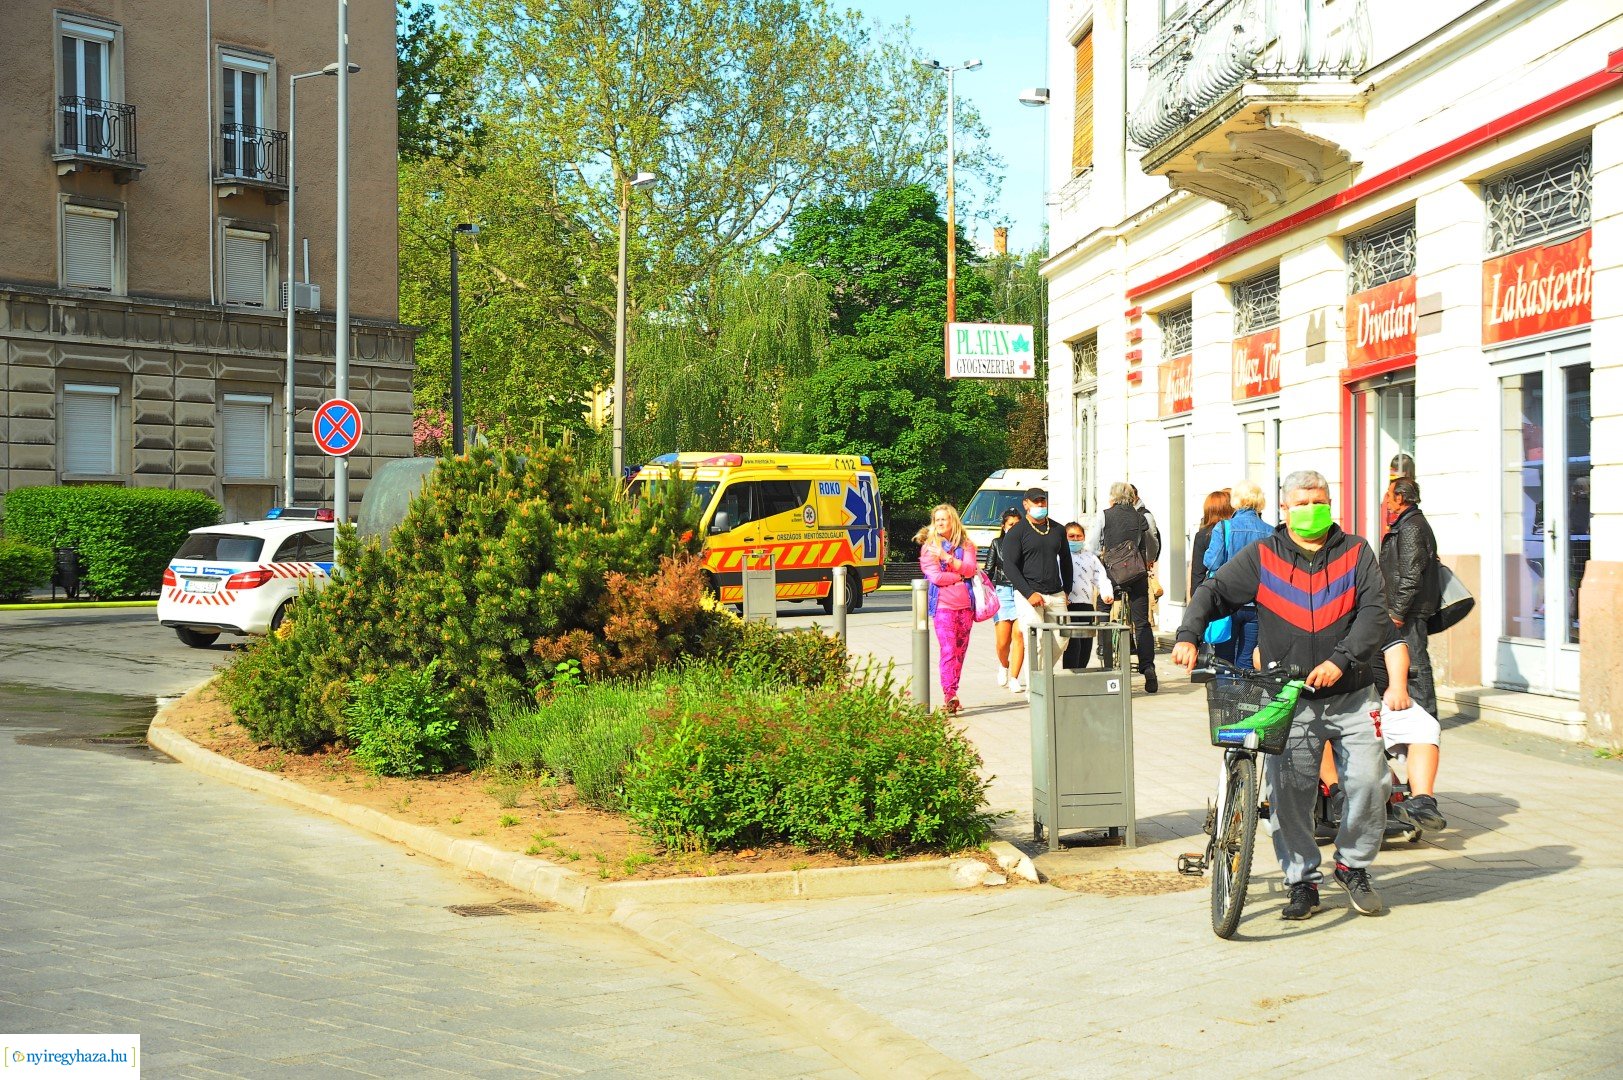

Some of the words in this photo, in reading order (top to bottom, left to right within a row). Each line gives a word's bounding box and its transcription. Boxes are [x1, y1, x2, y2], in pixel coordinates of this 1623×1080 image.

[1235, 348, 1262, 392] Olasz,
[841, 459, 856, 470] 112
[819, 482, 841, 495] ROKO
[777, 532, 802, 541] ORSZÁGOS
